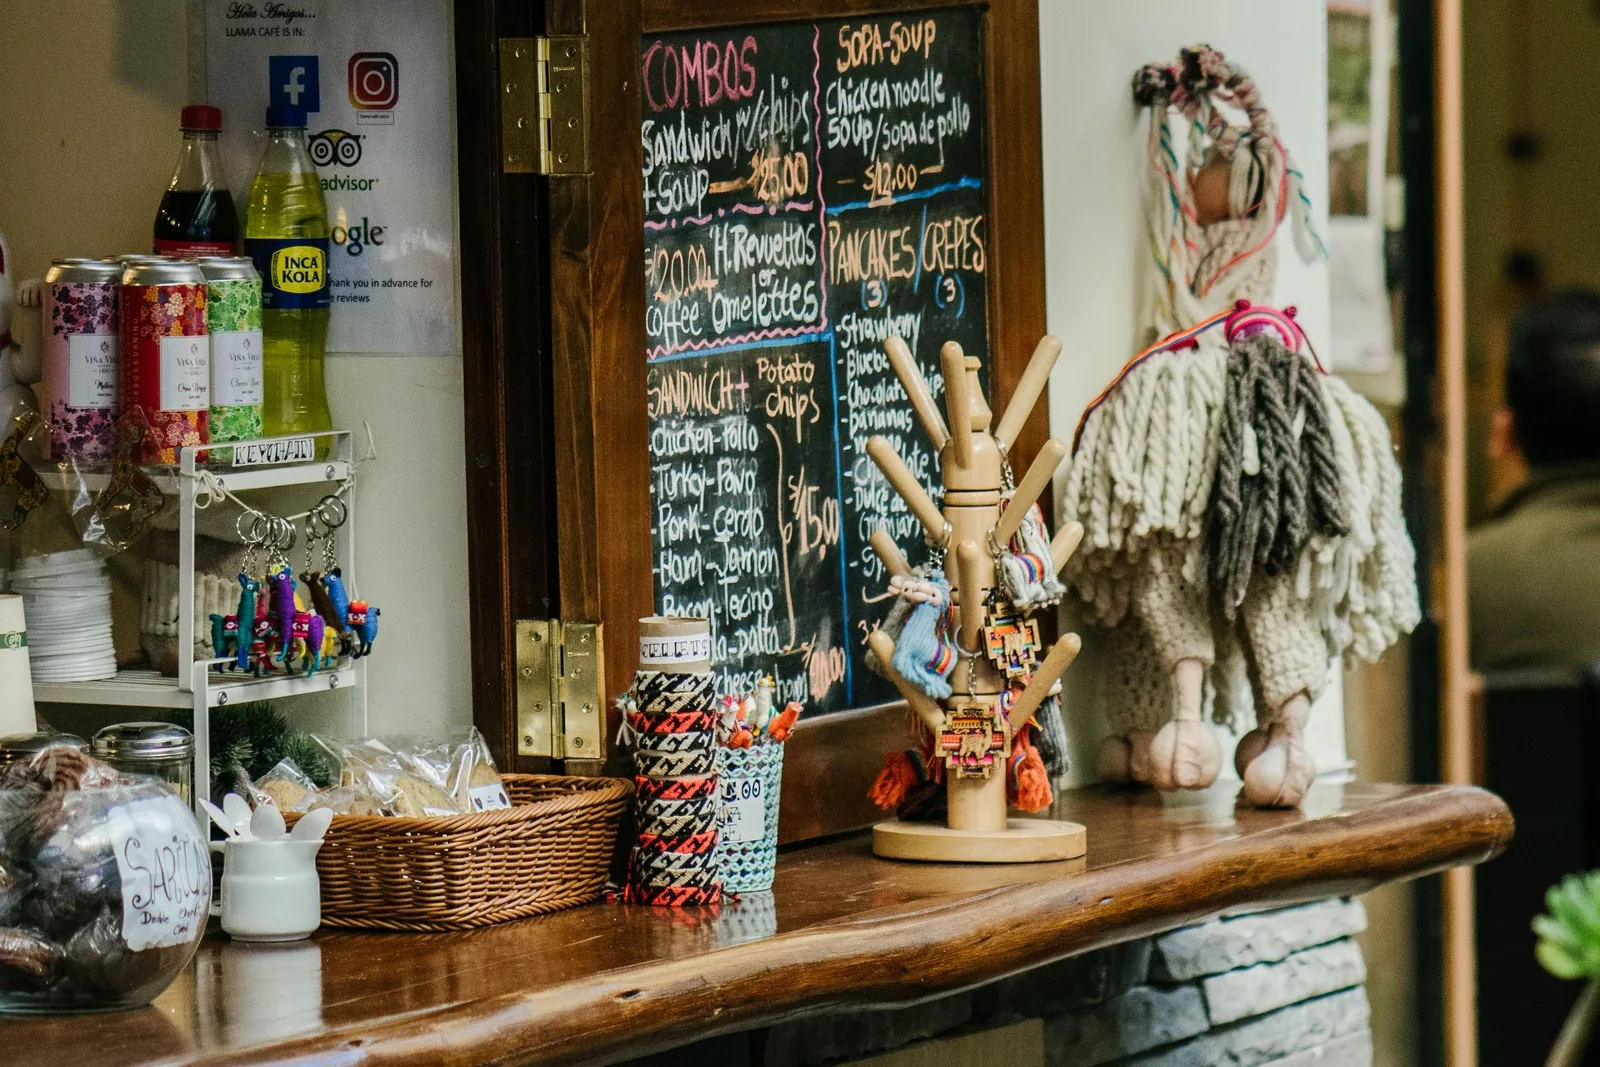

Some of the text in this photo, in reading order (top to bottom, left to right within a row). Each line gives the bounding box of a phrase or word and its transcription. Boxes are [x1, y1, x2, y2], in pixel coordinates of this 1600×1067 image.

[226, 2, 257, 19] Hola
[226, 26, 305, 37] LLAMA CAFÉ IS IN:
[643, 36, 758, 112] COMBOS
[826, 68, 945, 116] Chicken noodle
[919, 112, 934, 145] de
[938, 93, 971, 166] pollo
[642, 106, 733, 176] Sandwich
[322, 175, 374, 192] advisor
[331, 217, 385, 257] ogle
[284, 256, 319, 269] INCA
[281, 270, 320, 283] KOLA
[328, 277, 433, 289] hank you in advance for
[758, 268, 777, 287] or
[336, 293, 370, 303] reviews
[757, 352, 815, 385] Potato
[235, 439, 313, 465] KEYCHAIN
